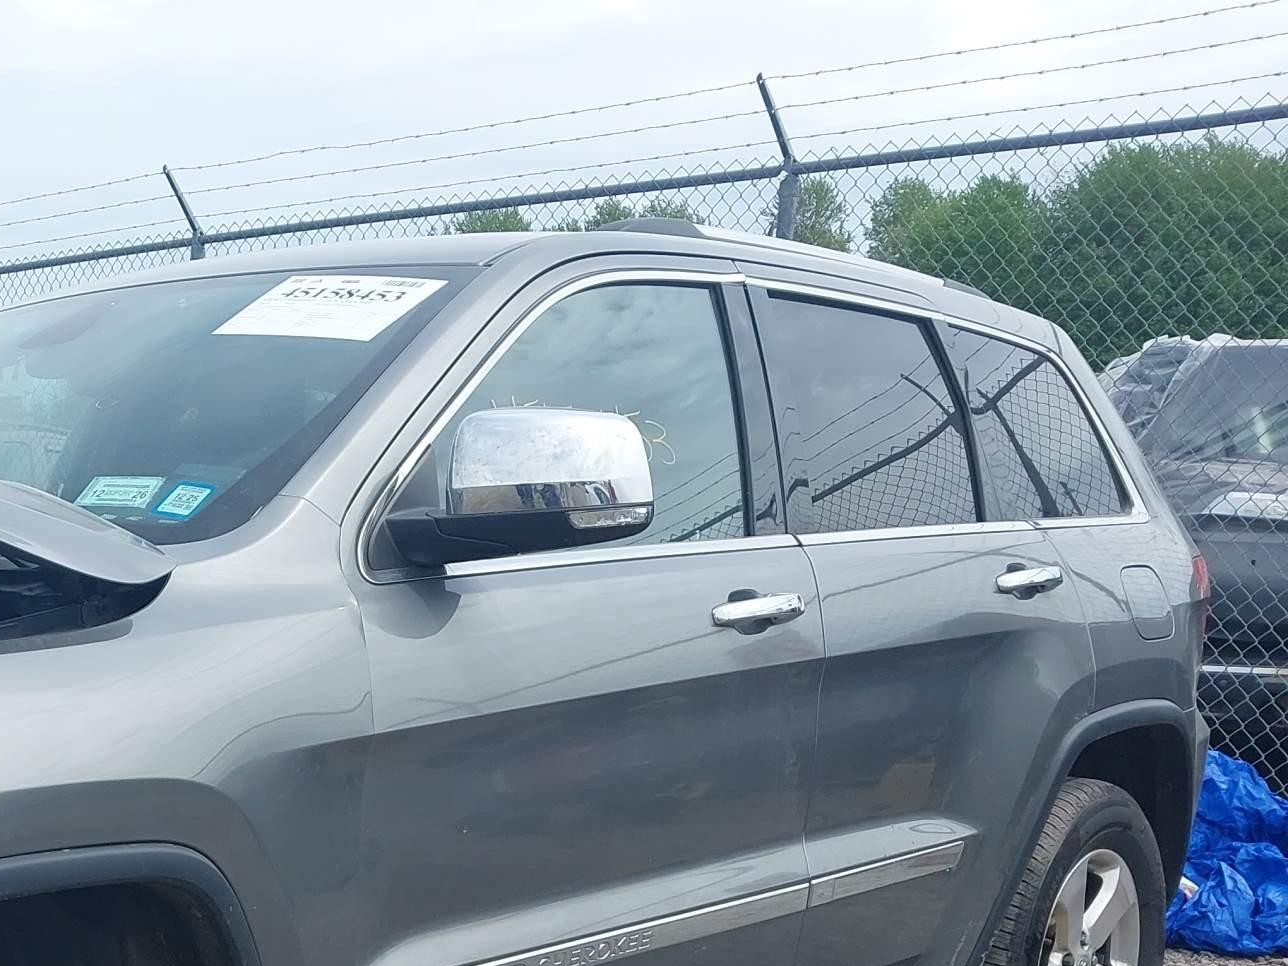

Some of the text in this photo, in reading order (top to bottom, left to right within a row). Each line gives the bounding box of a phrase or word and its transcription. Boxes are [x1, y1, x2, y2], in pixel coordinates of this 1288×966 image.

[281, 287, 407, 302] 45158453
[90, 489, 106, 498] 12
[131, 490, 149, 499] 26
